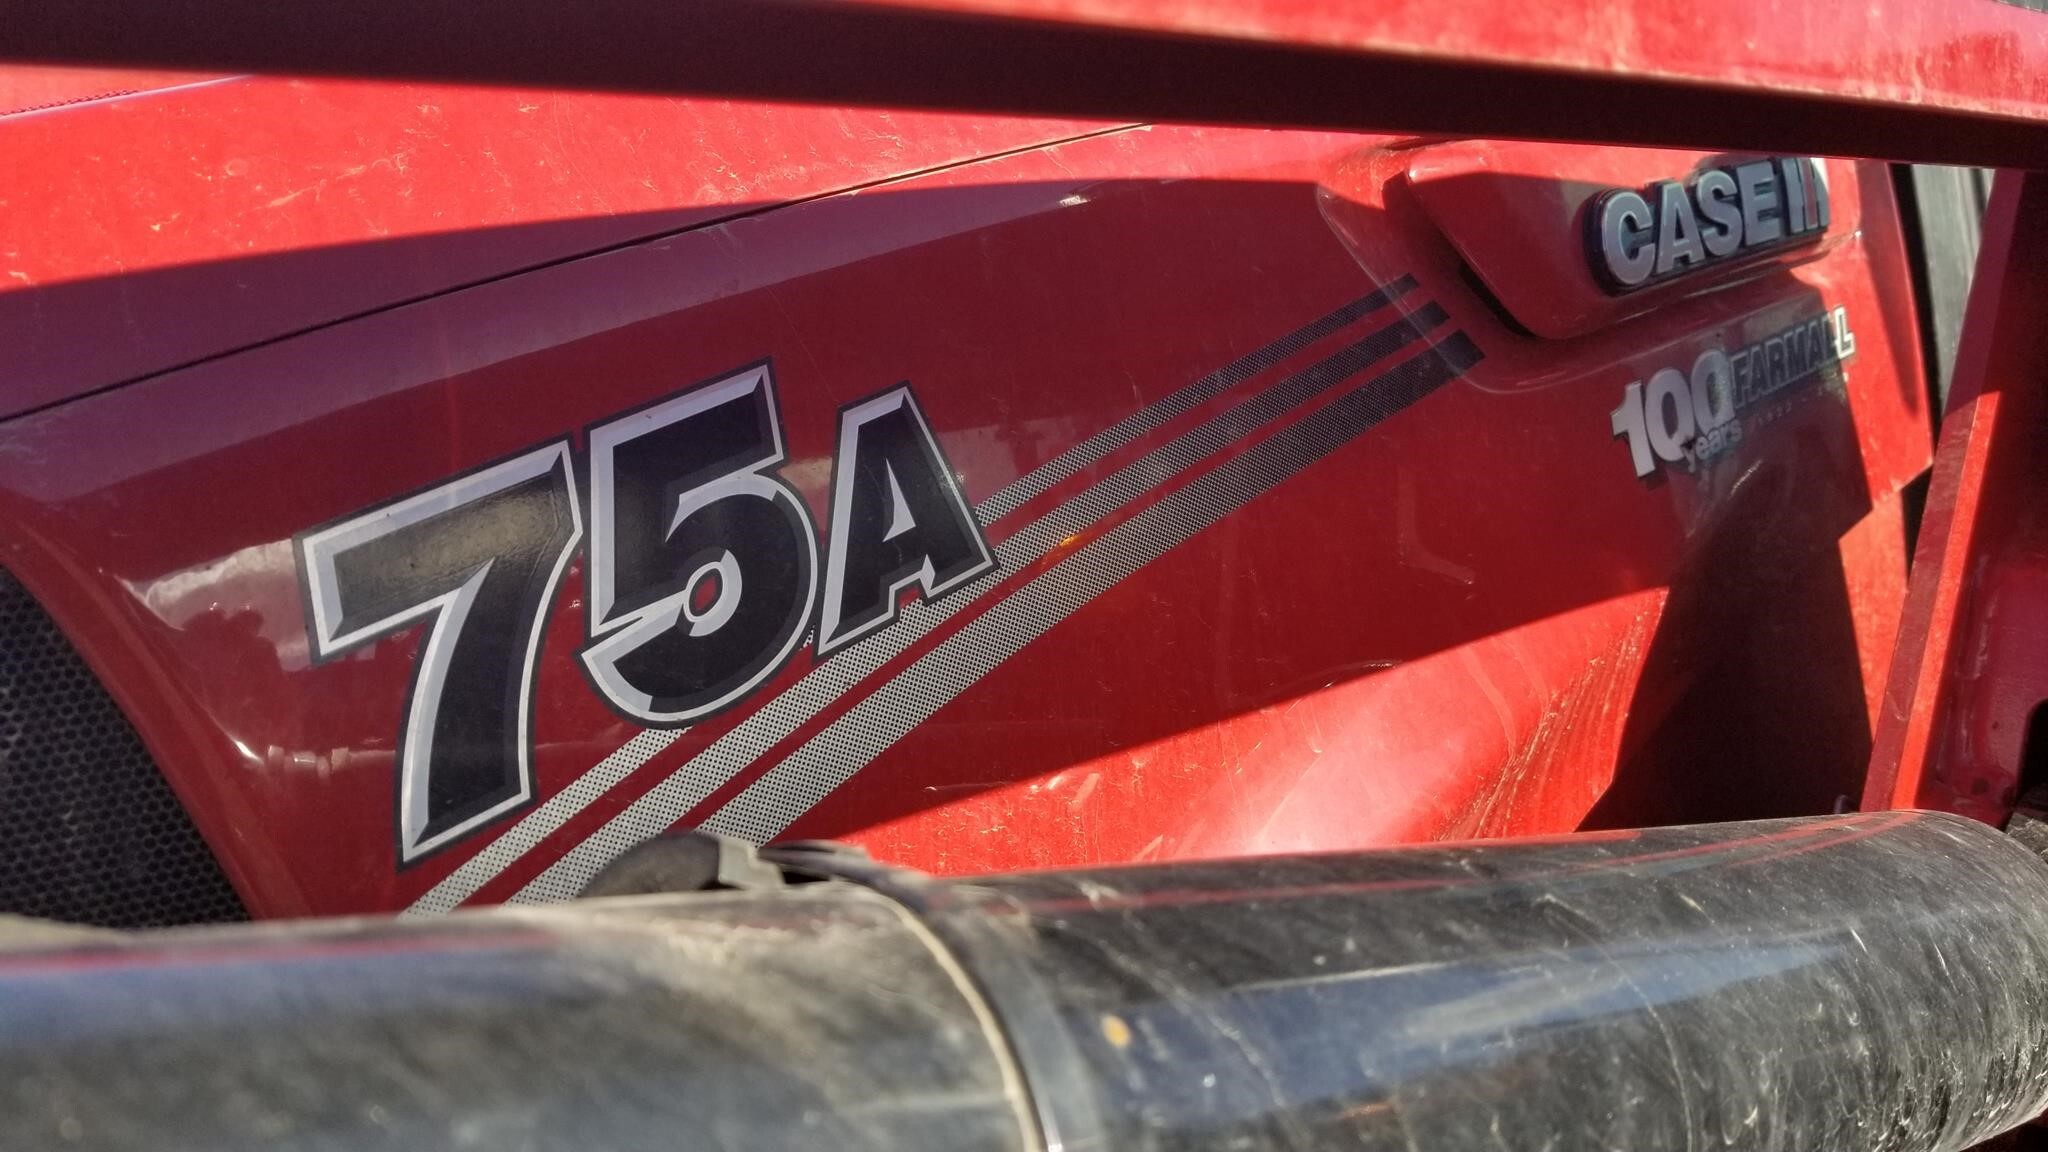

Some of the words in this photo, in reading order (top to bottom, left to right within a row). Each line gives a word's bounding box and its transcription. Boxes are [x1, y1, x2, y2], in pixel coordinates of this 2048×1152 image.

[1601, 160, 1781, 286] CASE
[1611, 350, 1736, 478] 100
[1729, 305, 1855, 409] FARMALL
[1681, 418, 1742, 474] years
[297, 360, 998, 870] 75A
